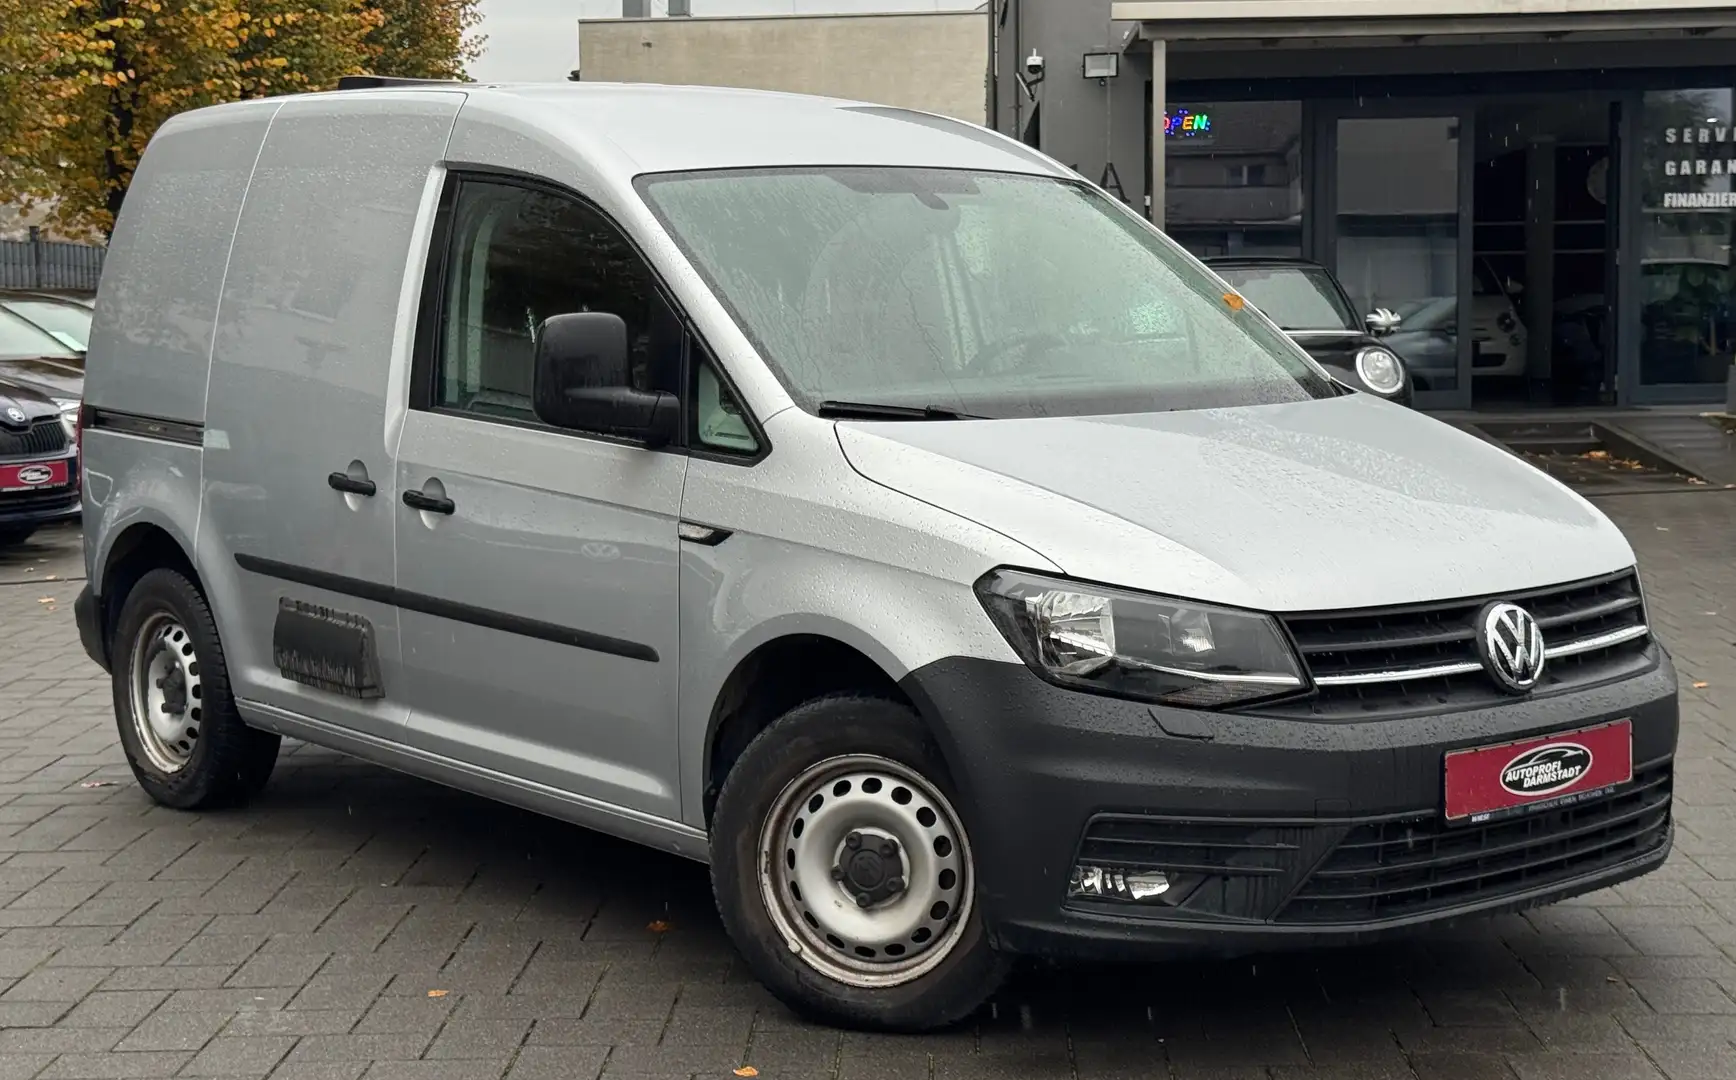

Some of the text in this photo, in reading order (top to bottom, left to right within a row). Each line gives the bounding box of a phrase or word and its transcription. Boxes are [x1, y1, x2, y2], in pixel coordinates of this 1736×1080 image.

[1164, 114, 1208, 130] OPEN
[1665, 160, 1736, 176] GARAN
[1663, 192, 1736, 208] FINANZIER
[1505, 760, 1562, 783] AUTOPROFI
[1523, 764, 1582, 789] DARMSTADT
